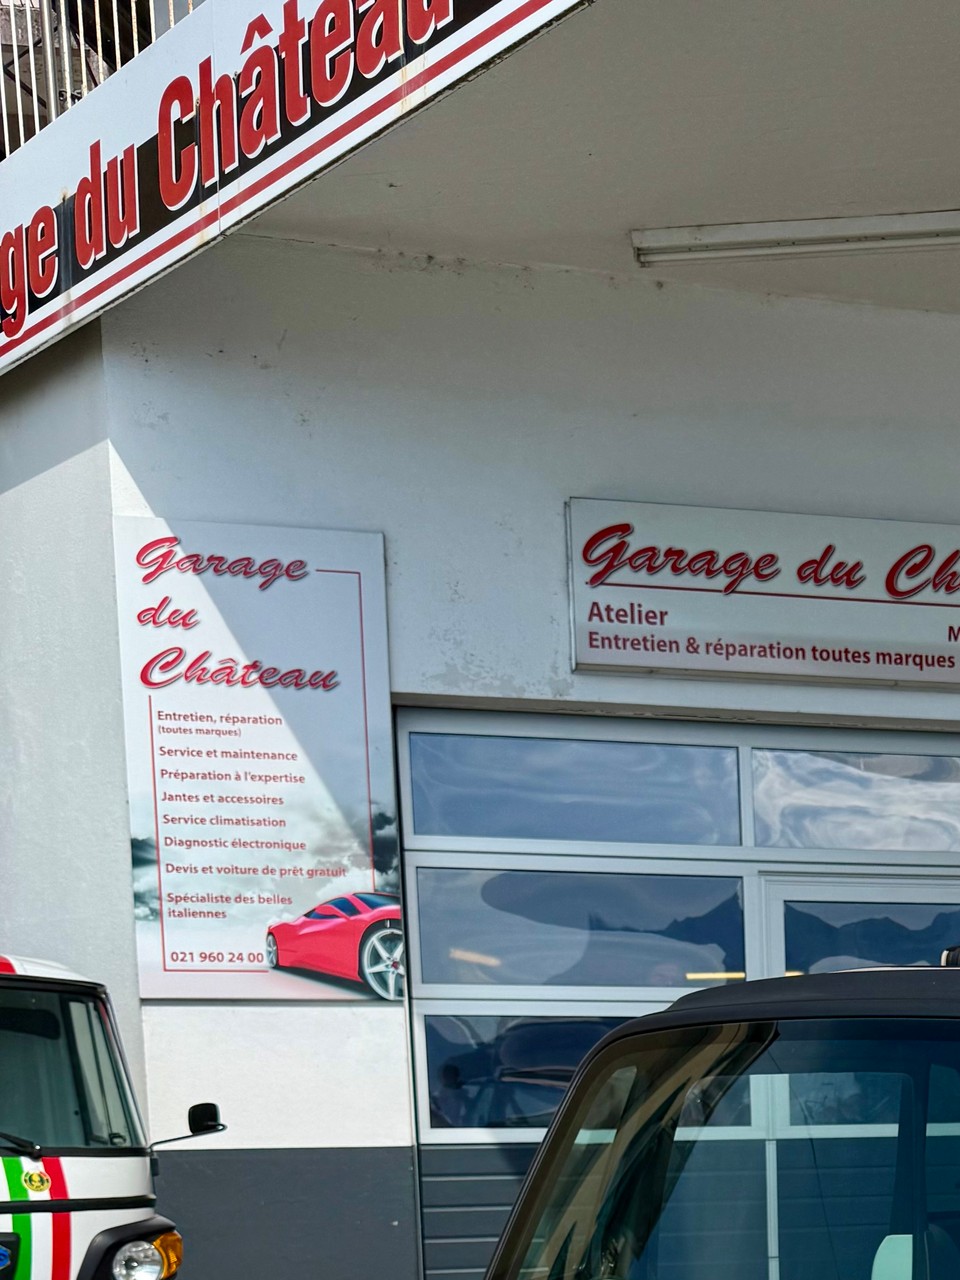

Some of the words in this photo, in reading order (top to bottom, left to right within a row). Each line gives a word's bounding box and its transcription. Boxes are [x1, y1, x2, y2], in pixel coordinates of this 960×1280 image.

[74, 139, 140, 270] du
[136, 536, 309, 590] Garage
[582, 522, 781, 595] Garage
[797, 543, 866, 589] du
[137, 596, 199, 630] du
[588, 601, 668, 626] Atelier
[588, 631, 680, 654] Entretien
[685, 636, 700, 655] &
[705, 637, 806, 661] réparation
[811, 645, 871, 665] toutes
[876, 651, 955, 672] marques
[139, 647, 340, 691] Château
[157, 710, 217, 724] Entretien,
[219, 713, 283, 726] réparation
[158, 725, 193, 735] (toutes
[195, 727, 242, 738] marques)
[159, 746, 203, 758] Service
[206, 749, 218, 758] et
[221, 749, 298, 761] maintenance
[160, 769, 232, 782] Préparation
[234, 771, 241, 781] à
[245, 772, 305, 785] l'expertise
[161, 792, 200, 802] Jantes
[203, 793, 215, 803] et
[218, 794, 285, 806] accessoires
[163, 814, 207, 825] Service
[209, 815, 286, 827] climatisation
[164, 836, 229, 850] Diagnostic
[231, 837, 307, 851] électronique
[165, 863, 199, 875] Devis
[201, 864, 214, 875] et
[216, 865, 258, 876] voiture
[262, 865, 277, 877] de
[279, 866, 304, 879] prêt
[306, 866, 347, 880] gratuit
[167, 892, 231, 905] Spécialiste
[234, 893, 255, 904] des
[258, 893, 293, 905] belles
[168, 907, 228, 919] italiennes
[170, 951, 195, 963] 021
[199, 952, 225, 963] 960
[228, 952, 244, 963] 24
[247, 952, 264, 964] 00
